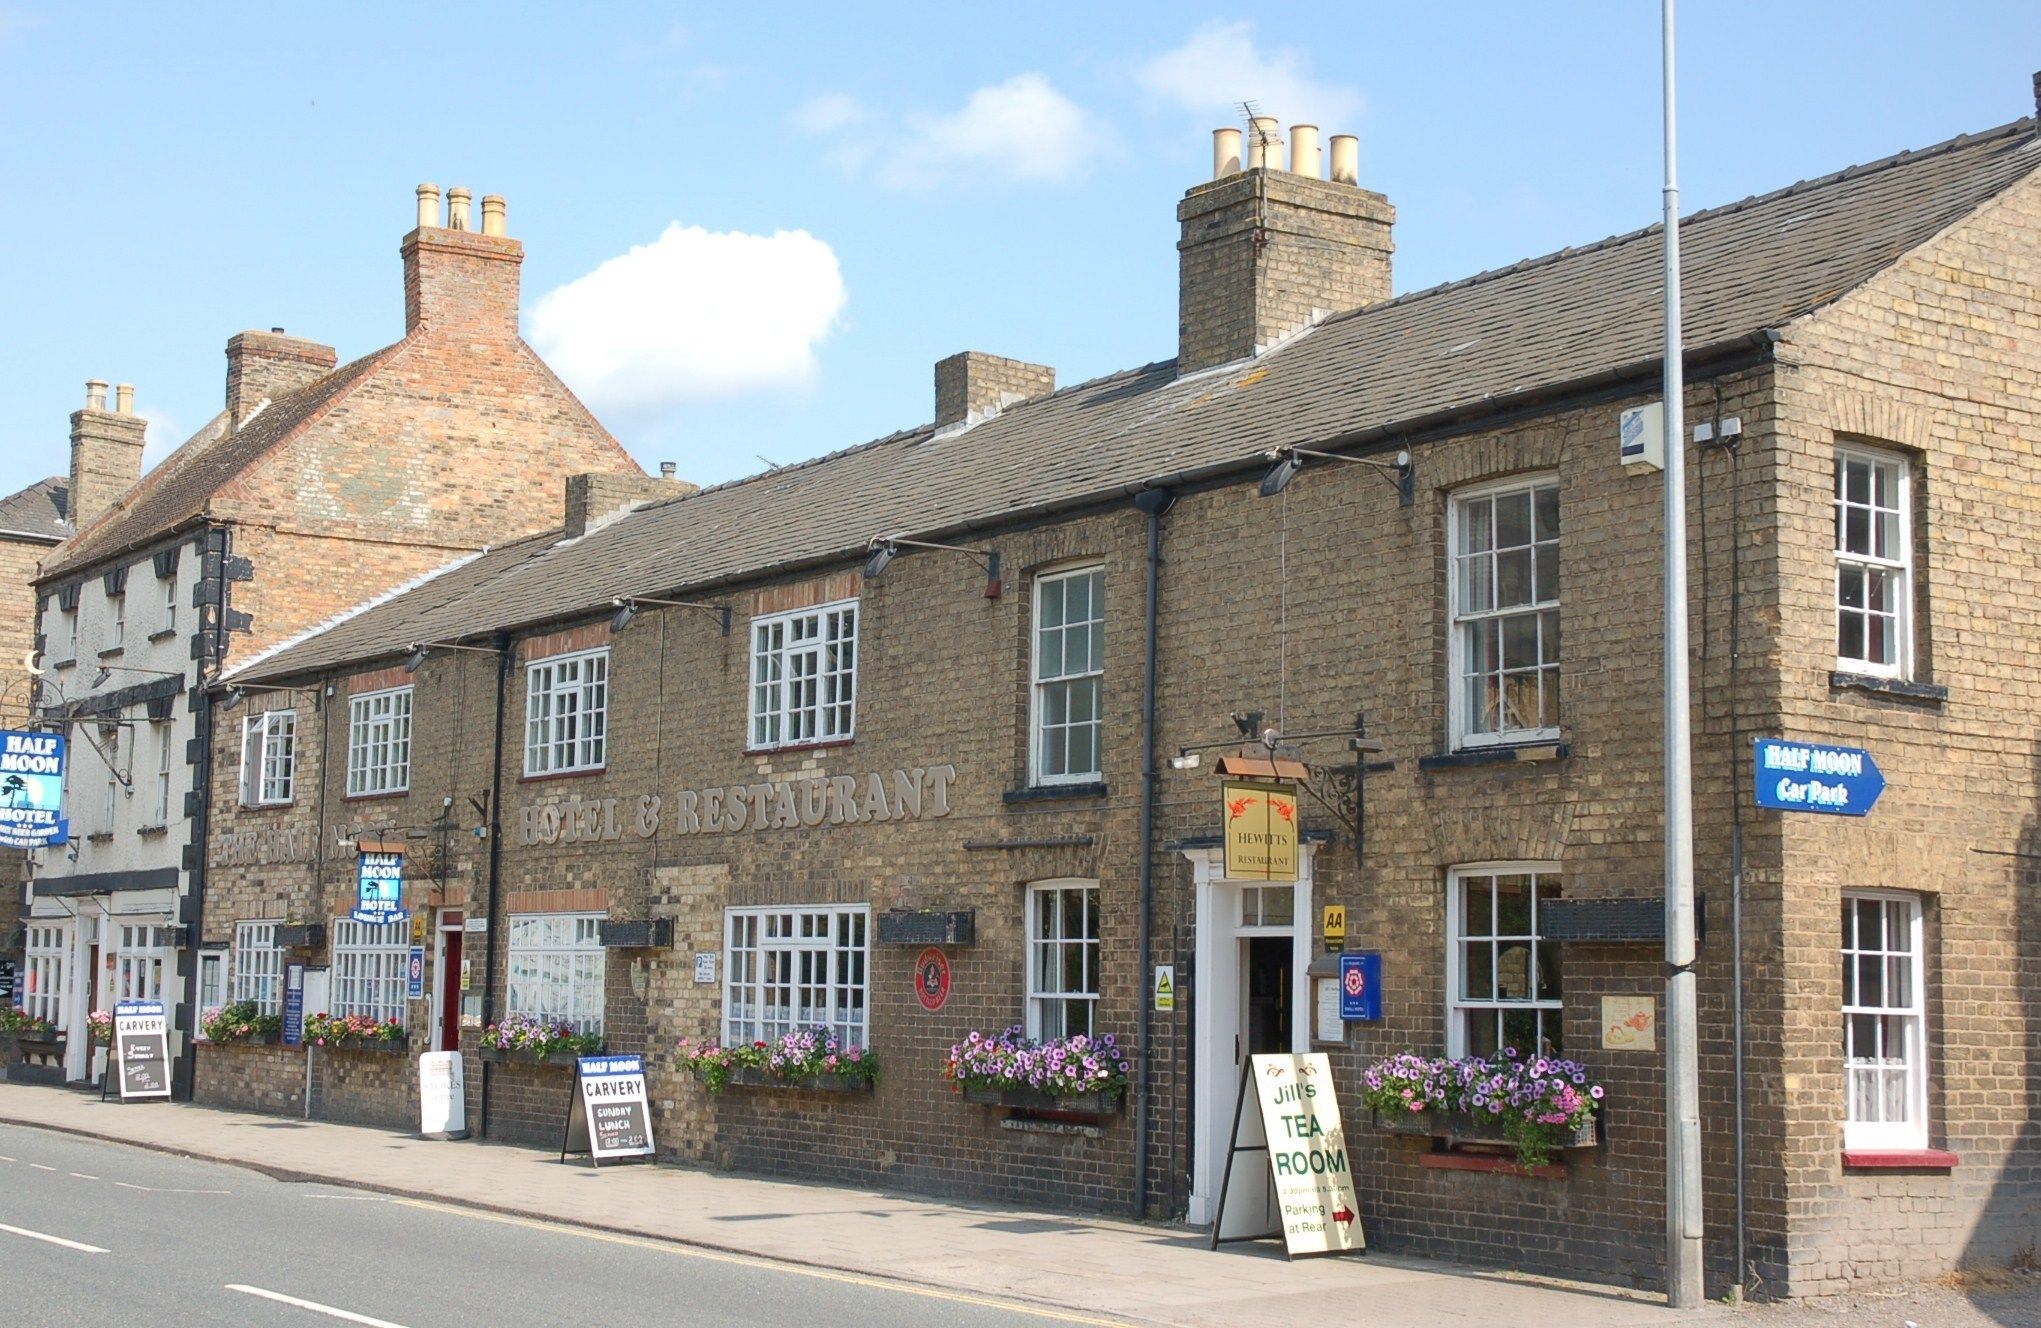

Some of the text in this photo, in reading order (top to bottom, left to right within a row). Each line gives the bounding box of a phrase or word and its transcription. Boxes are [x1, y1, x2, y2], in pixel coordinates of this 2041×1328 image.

[6, 735, 57, 755] HALF
[0, 753, 59, 773] MOON
[1764, 745, 1862, 777] HALF MOON
[1776, 777, 1848, 806] Car Park
[518, 764, 956, 847] HOTEL & RESTAURANT
[0, 808, 55, 824] HOTEL
[1238, 832, 1288, 846] HEWITTS
[218, 832, 258, 867] THE
[365, 853, 398, 865] HALF
[1237, 855, 1288, 866] RESTAURANT
[361, 865, 400, 879] MOON
[361, 900, 397, 911] HOTEL
[1326, 912, 1342, 929] AA
[120, 1020, 163, 1031] CARVERY
[582, 1059, 640, 1073] HALF MOON
[586, 1080, 641, 1097] CARVERY
[1273, 1083, 1317, 1105] Jill's
[597, 1106, 632, 1118] SUNDAY
[598, 1119, 631, 1131] LUNCH
[1281, 1114, 1325, 1139] TEA
[1275, 1149, 1347, 1177] ROOM
[1285, 1204, 1326, 1217] Parking
[1289, 1221, 1327, 1234] at Rear
